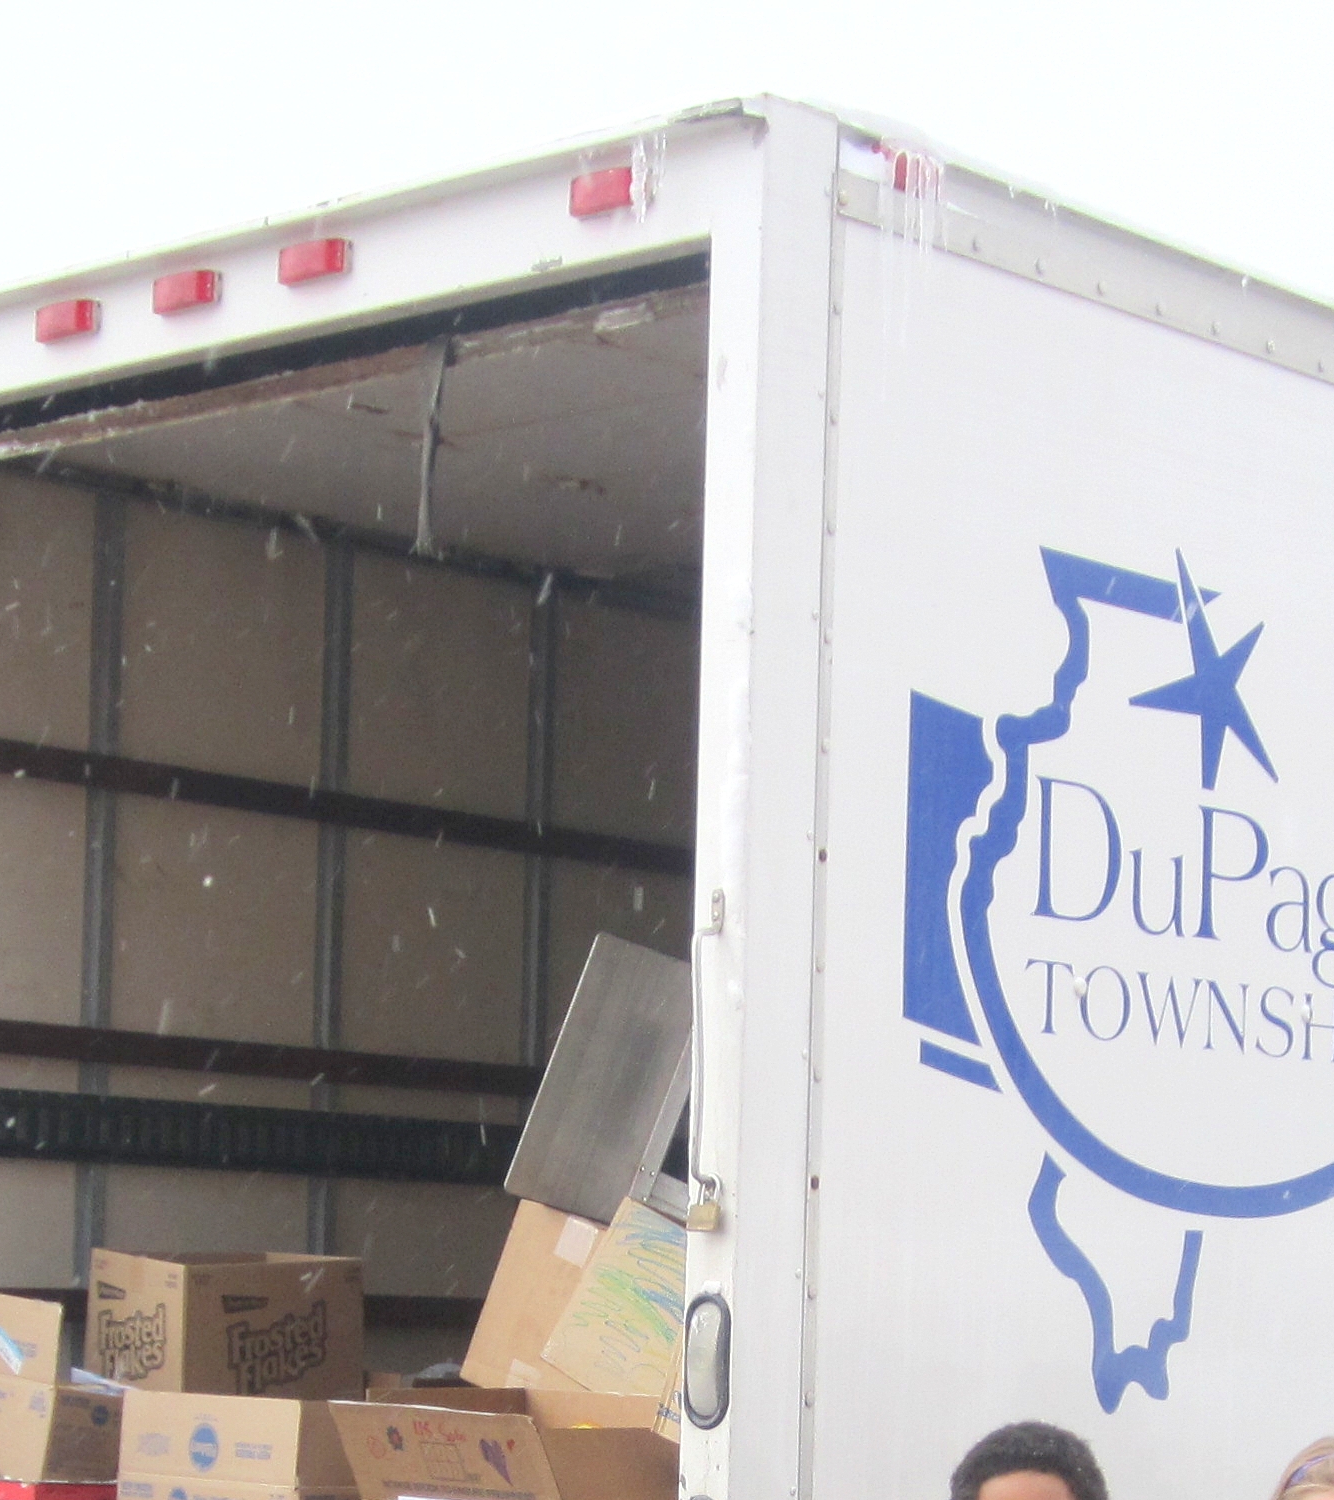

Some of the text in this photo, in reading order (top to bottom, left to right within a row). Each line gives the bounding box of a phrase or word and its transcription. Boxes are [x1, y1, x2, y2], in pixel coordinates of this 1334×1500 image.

[98, 1302, 166, 1352] Frosted
[226, 1299, 327, 1368] Frosted
[101, 1344, 165, 1380] Flakes
[236, 1345, 326, 1396] Flakes
